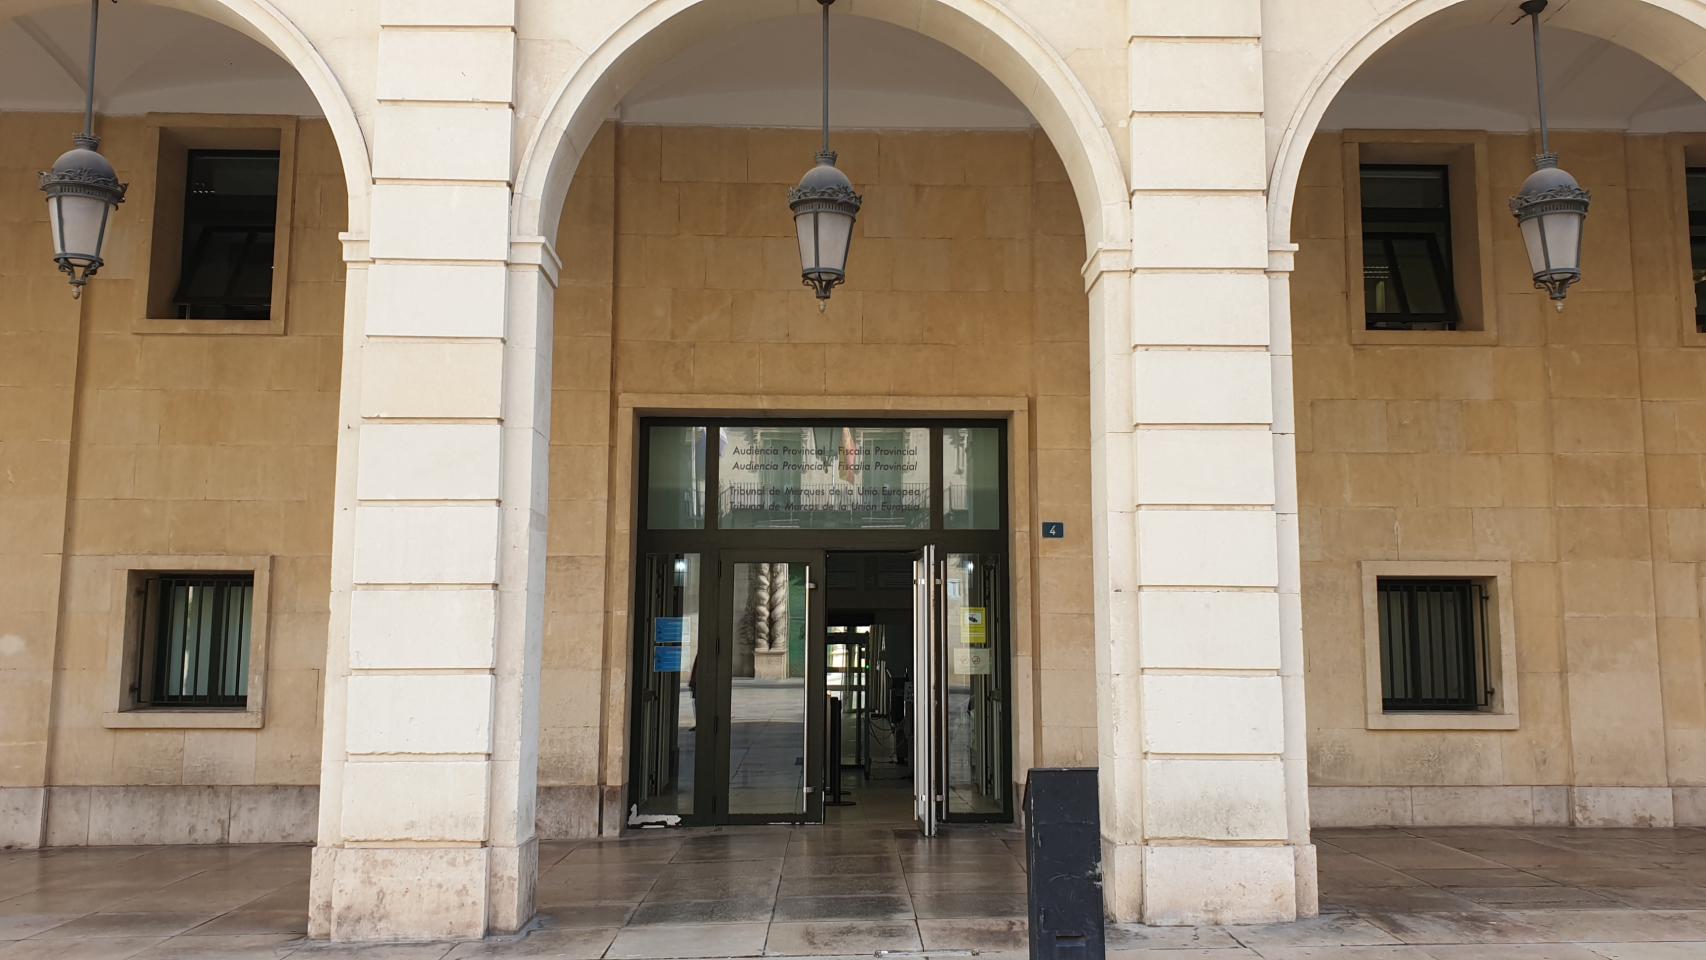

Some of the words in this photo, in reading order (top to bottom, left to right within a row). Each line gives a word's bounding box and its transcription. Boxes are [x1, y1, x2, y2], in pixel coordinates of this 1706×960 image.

[783, 446, 825, 455] Provincial
[875, 446, 918, 455] Provincial
[732, 461, 778, 470] Audiencia
[782, 461, 826, 470] Provincial
[874, 461, 918, 470] Provincial
[730, 486, 765, 496] Tribunal
[769, 486, 780, 496] de
[829, 486, 841, 496] de
[846, 486, 854, 496] la
[882, 486, 920, 498] Europea
[730, 502, 766, 512] Tribunal
[769, 502, 780, 512] de
[822, 502, 834, 512] de
[881, 502, 921, 513] Europea
[1049, 525, 1056, 536] 4
